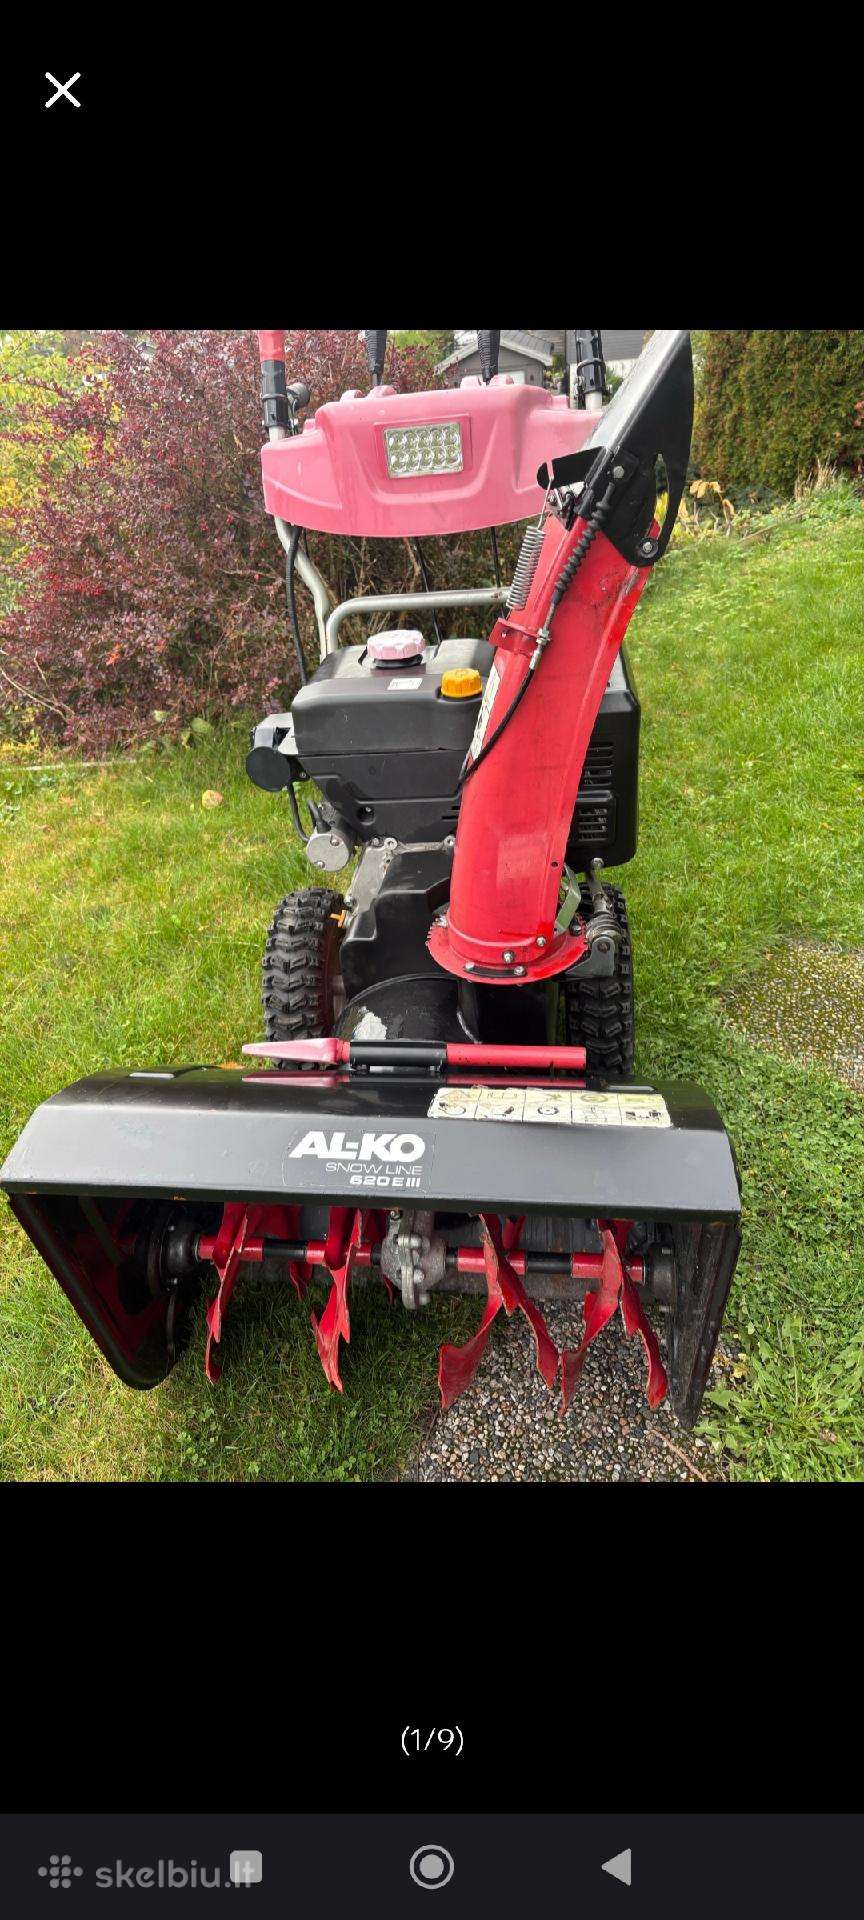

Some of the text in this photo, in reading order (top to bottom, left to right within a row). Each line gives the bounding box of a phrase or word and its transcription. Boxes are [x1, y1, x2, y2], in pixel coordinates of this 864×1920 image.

[288, 1131, 426, 1162] AL-KO
[325, 1162, 424, 1175] SNOW LINE
